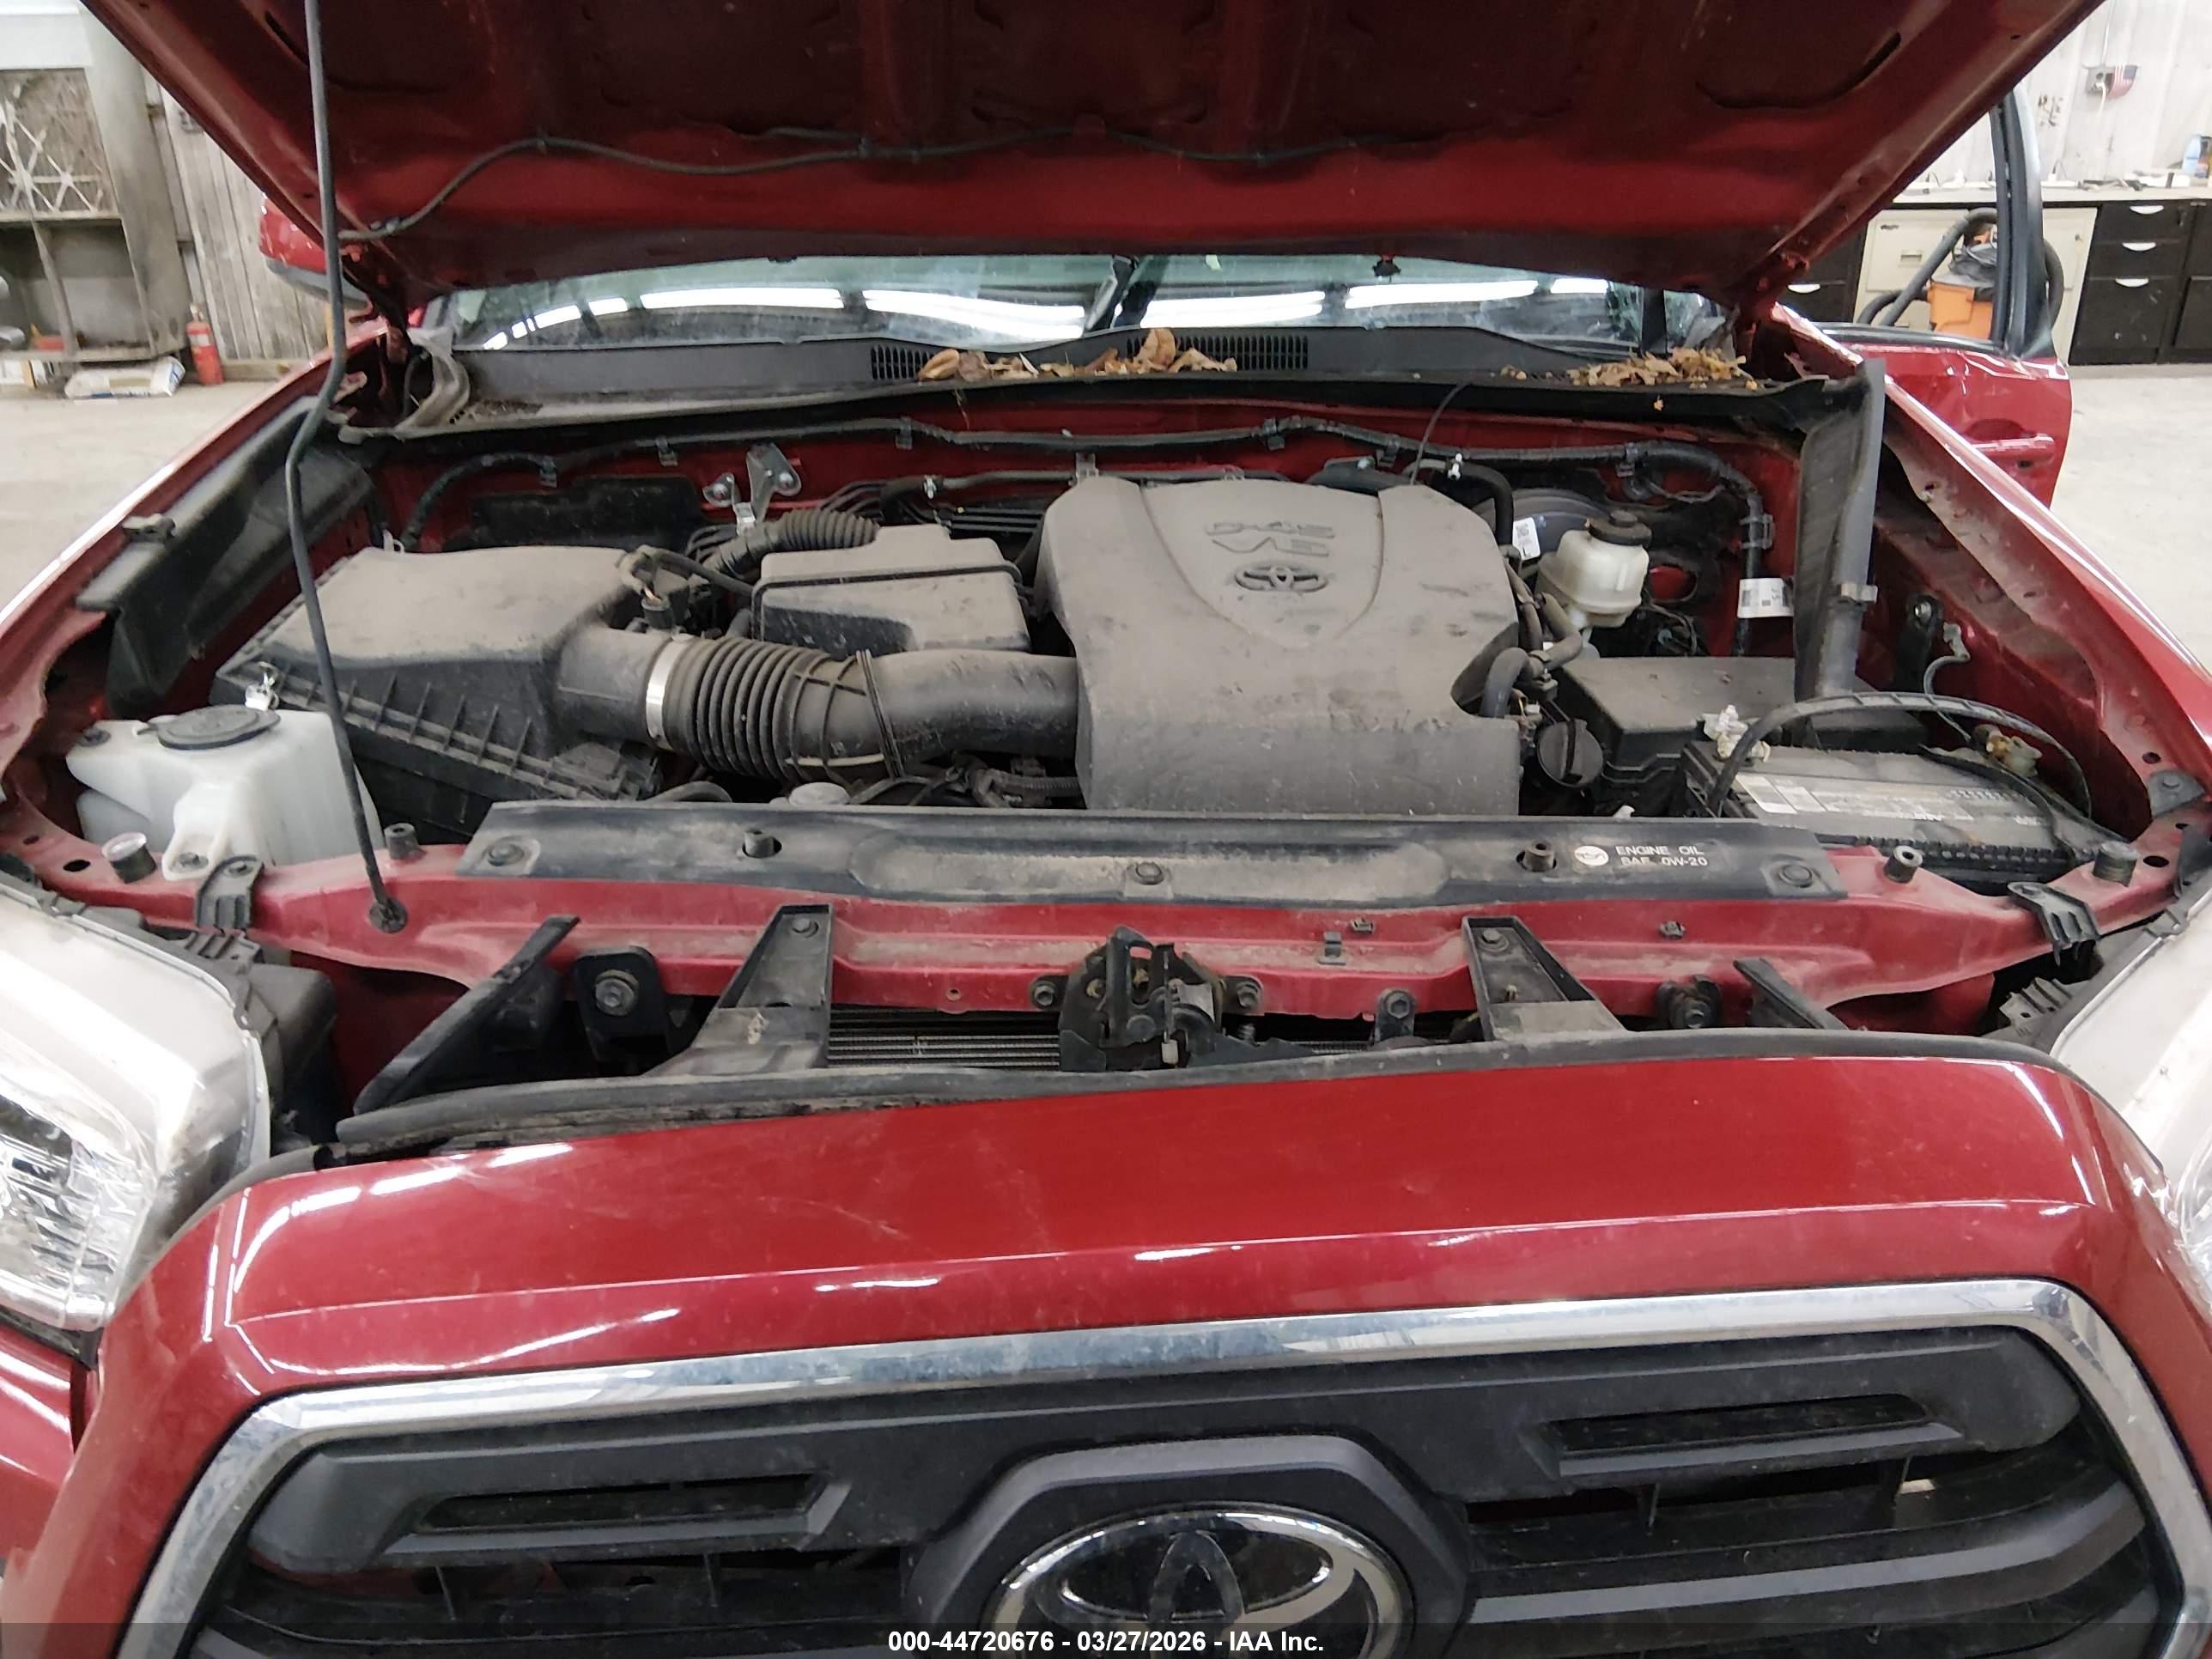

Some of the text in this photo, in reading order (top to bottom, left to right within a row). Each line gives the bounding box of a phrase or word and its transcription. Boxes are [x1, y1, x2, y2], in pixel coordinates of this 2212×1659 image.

[1615, 845, 1705, 855] ENGINE OIL
[1661, 856, 1708, 866] 0W-20
